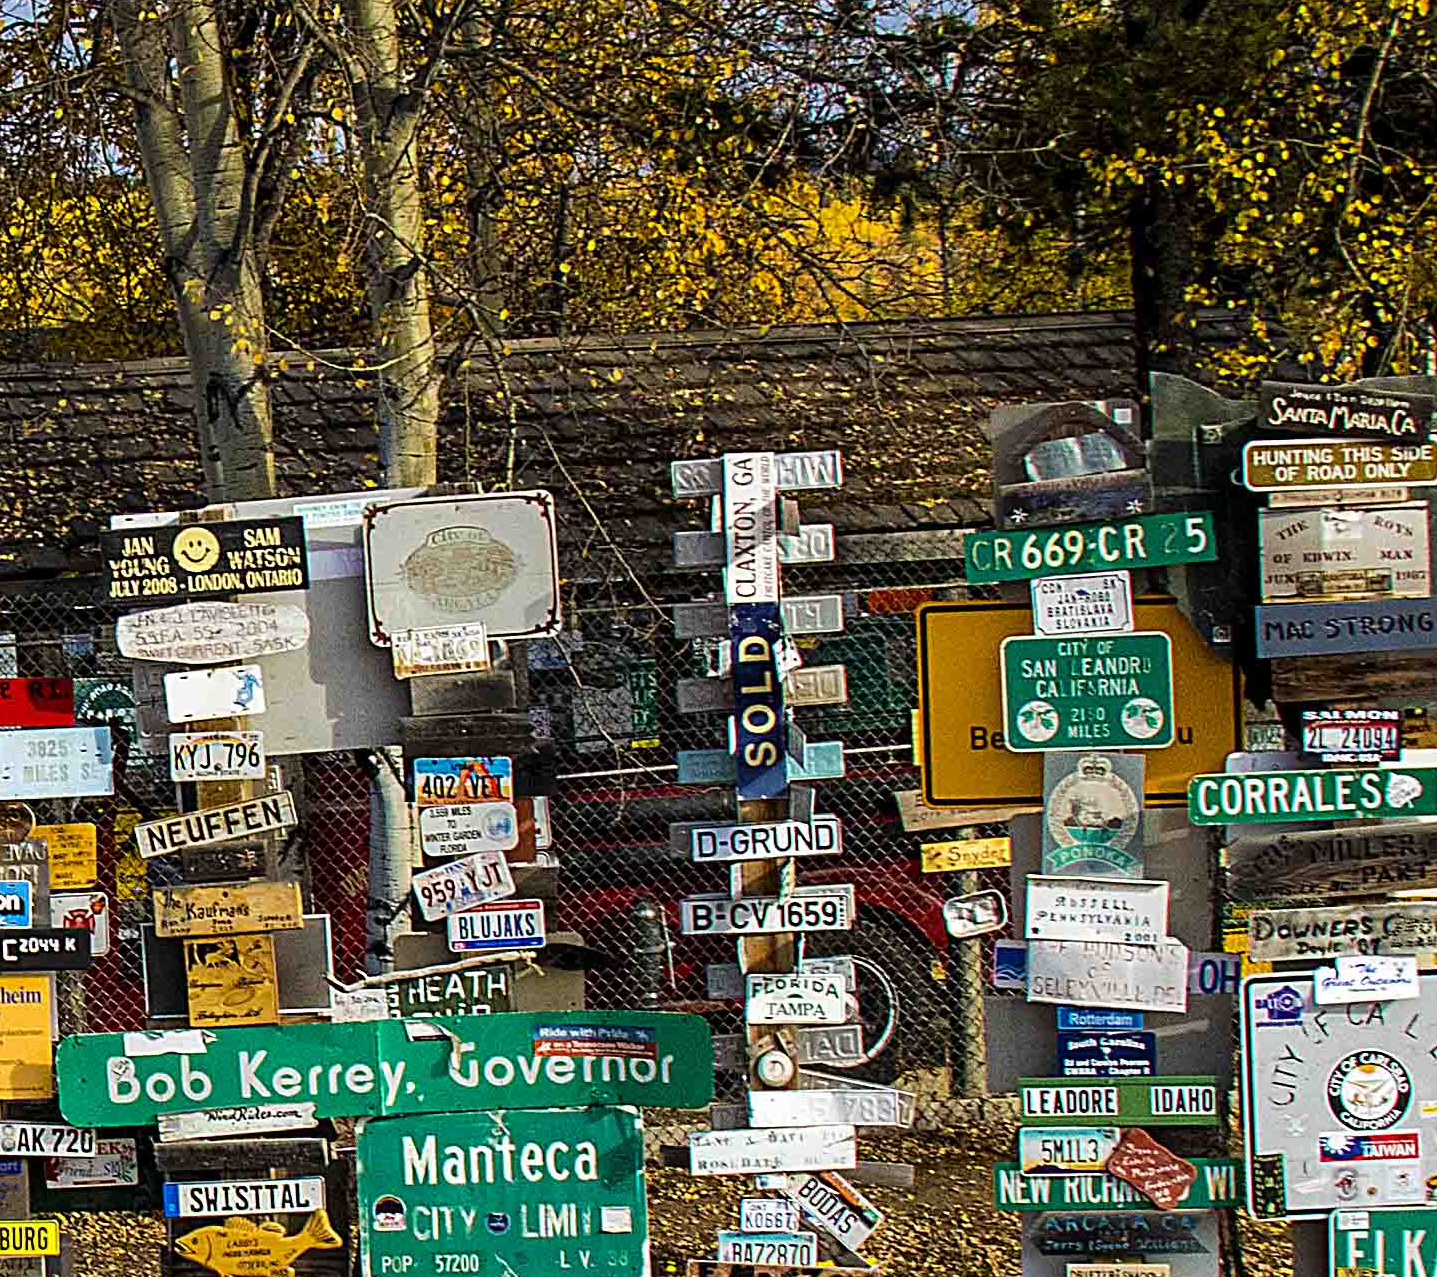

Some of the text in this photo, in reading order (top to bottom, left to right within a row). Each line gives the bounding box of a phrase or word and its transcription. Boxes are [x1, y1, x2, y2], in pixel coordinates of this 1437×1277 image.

[1253, 444, 1432, 466] HUNTING THIS SIDE
[1275, 461, 1411, 481] OF ROAD ONLY
[122, 528, 281, 557] JAN SAM
[109, 548, 301, 579] YOUNG WATSON
[109, 569, 303, 598] JULY 2008 LONDON, ONTARIO
[1265, 612, 1433, 641] MAC STRONG
[1302, 710, 1399, 721] SALMON
[147, 798, 282, 852] NEUFFEN
[459, 914, 536, 940] BLUJAKS
[766, 1002, 826, 1019] TAMPA
[1069, 1013, 1134, 1028] Rotterdam
[1026, 1088, 1214, 1115] LEADORE IDAHO
[403, 1135, 599, 1186] Manteca
[1362, 1140, 1417, 1157] TAIWAN
[189, 1182, 310, 1213] SWISTTAL
